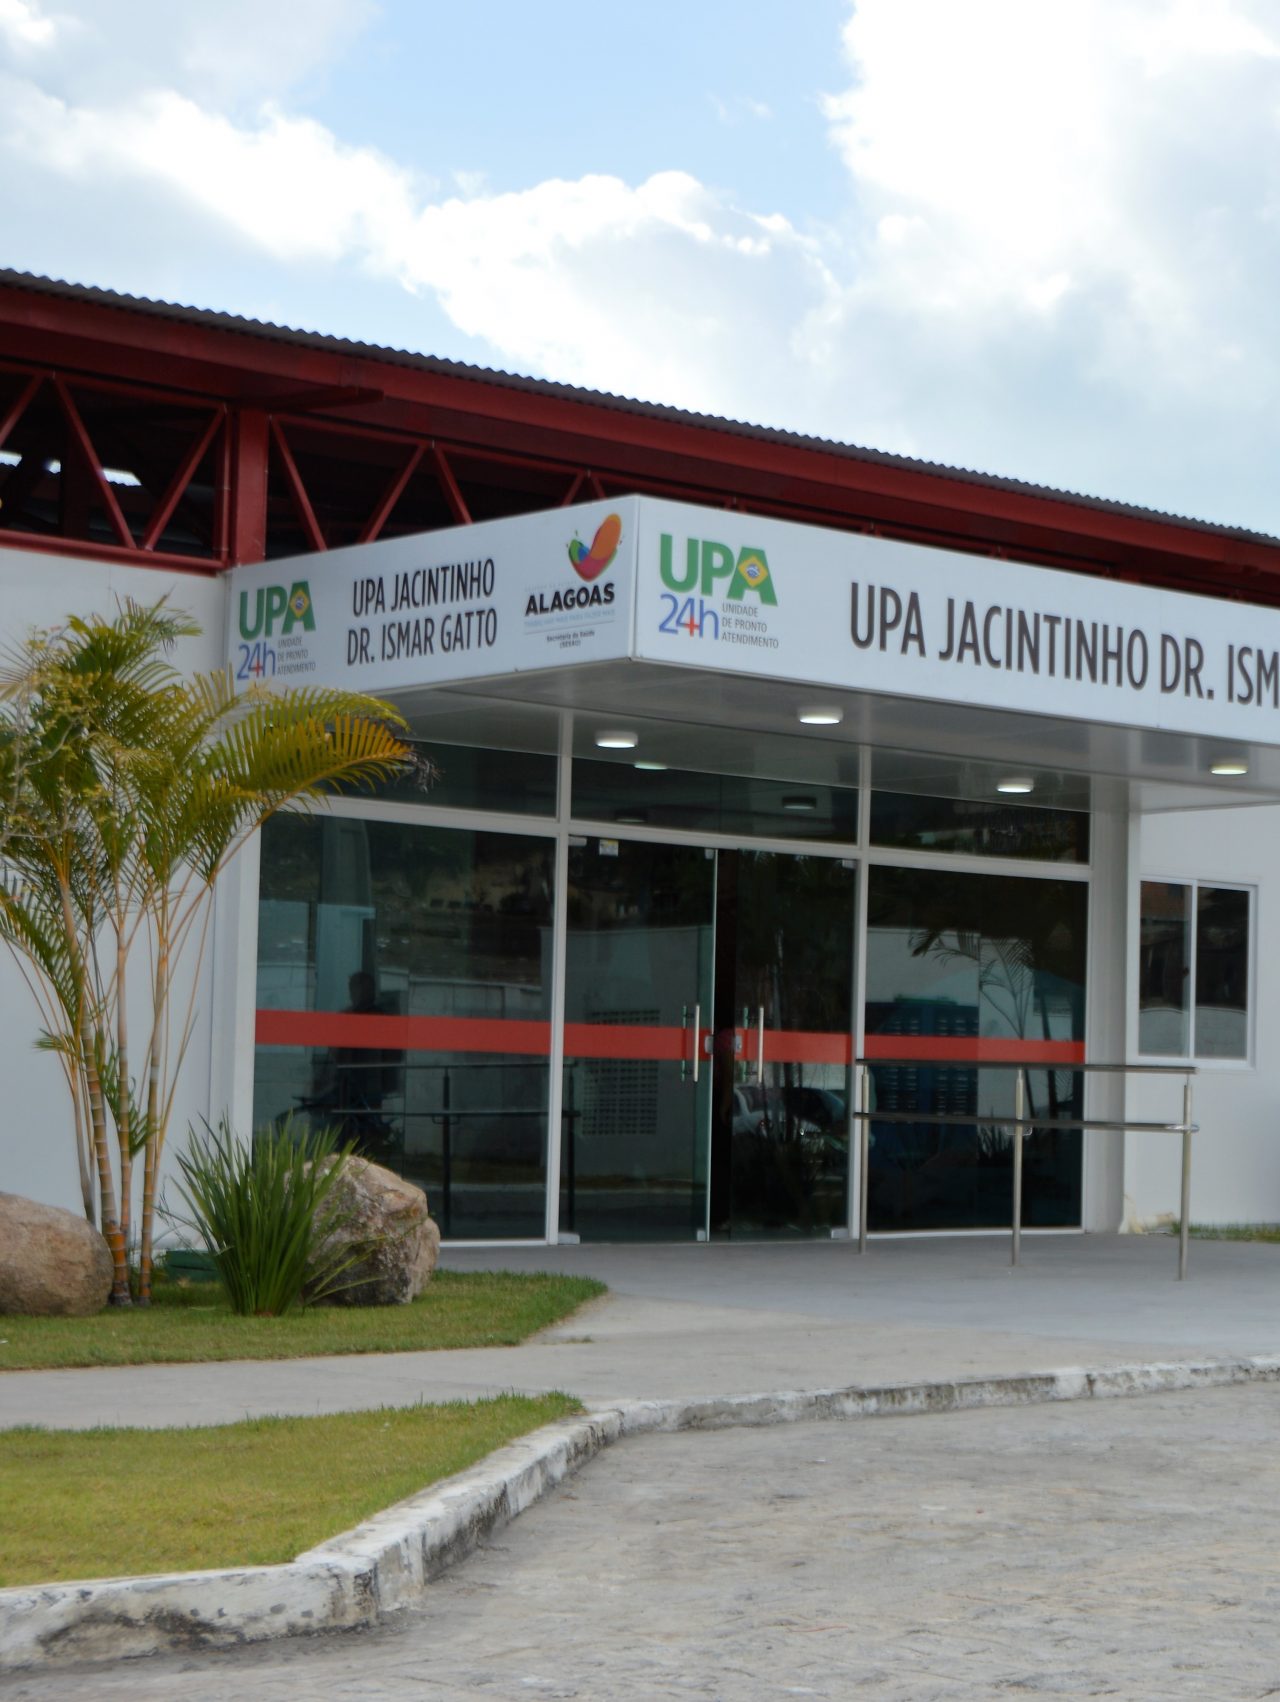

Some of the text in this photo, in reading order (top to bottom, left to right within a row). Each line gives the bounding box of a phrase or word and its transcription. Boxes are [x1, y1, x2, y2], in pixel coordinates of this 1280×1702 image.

[352, 558, 496, 618] UPA JACINTINHO
[660, 533, 778, 607] UPA
[239, 580, 317, 641] UPA
[524, 582, 616, 617] ALAGOAS
[658, 593, 719, 641] 24h
[722, 602, 759, 618] UNIDADE
[346, 626, 376, 666] DR.
[381, 617, 434, 662] ISMAR
[440, 608, 498, 652] GATTO
[721, 617, 768, 633] DE PRONTO
[721, 631, 779, 649] ATENDIMENTO
[850, 581, 927, 658] UPA
[938, 598, 1150, 692] JACINTINHO
[1160, 633, 1215, 700] DR.
[237, 641, 276, 680] 24h
